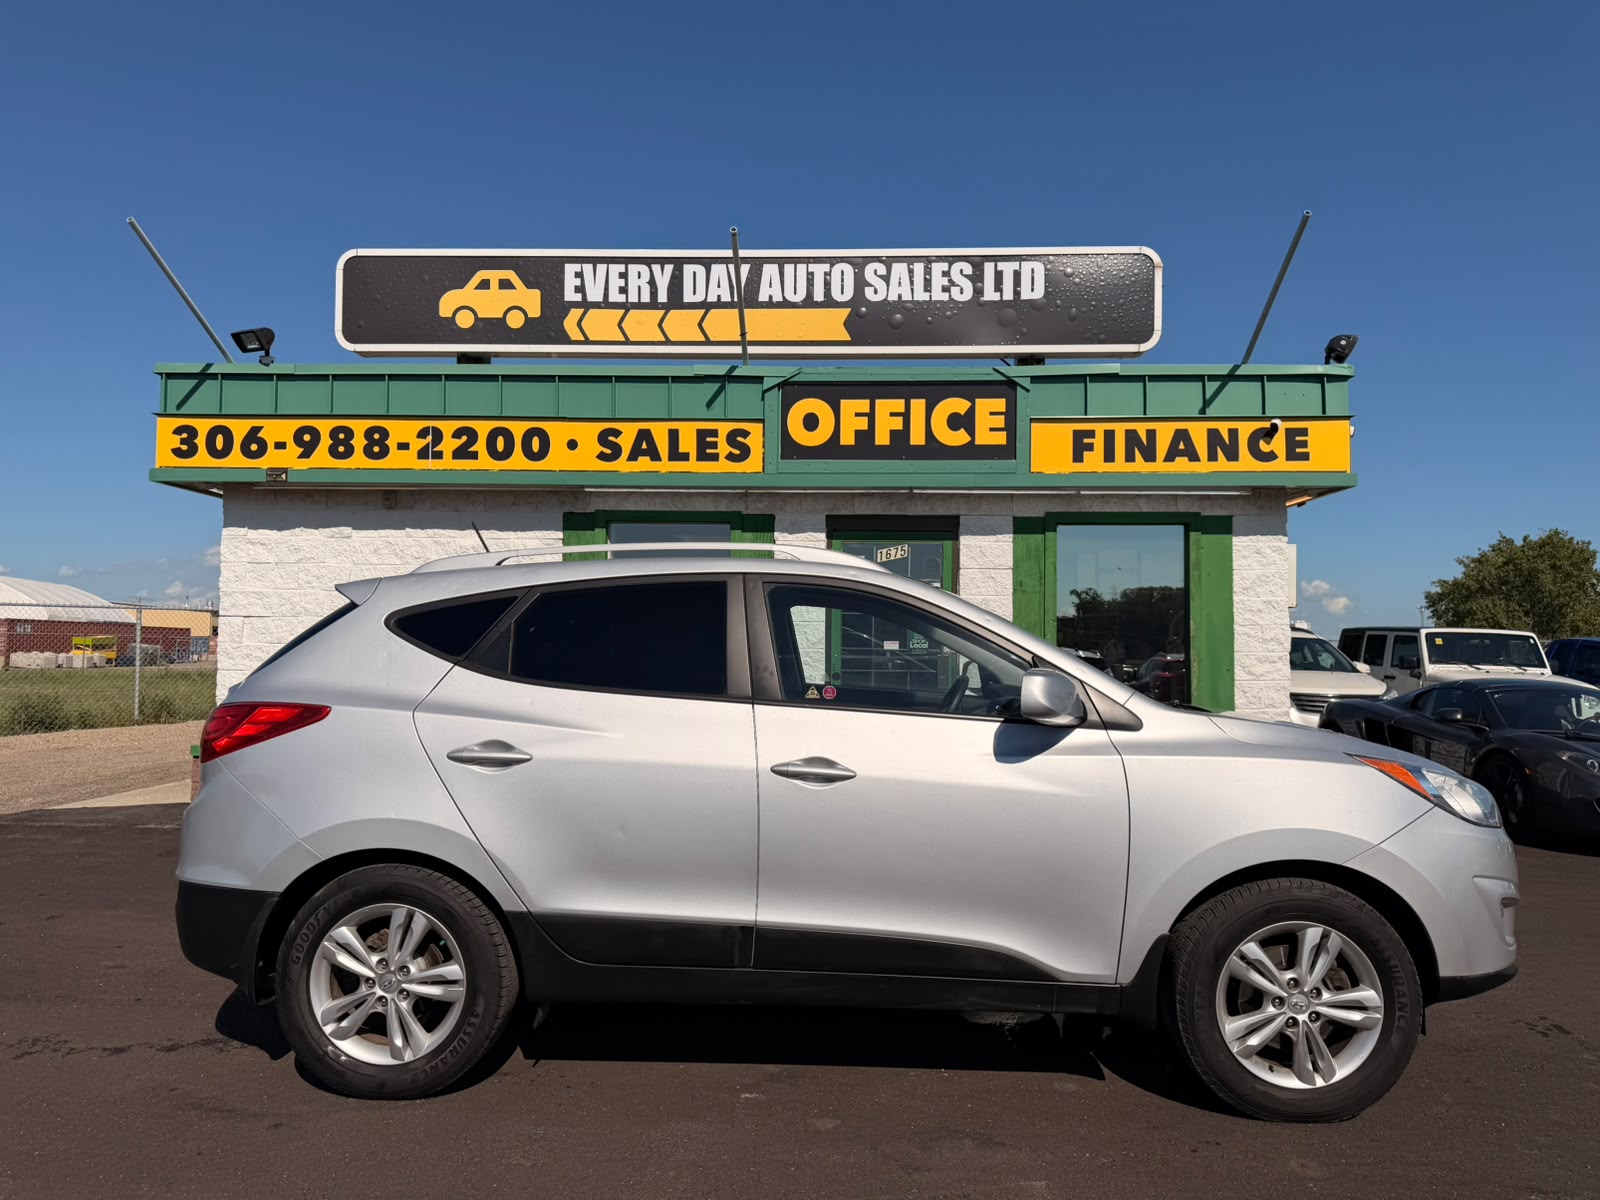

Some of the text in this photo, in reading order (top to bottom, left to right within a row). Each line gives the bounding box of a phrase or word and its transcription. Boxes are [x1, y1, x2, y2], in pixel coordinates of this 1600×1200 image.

[564, 261, 1046, 303] EVERY DAY AUTO SALES LTD
[787, 397, 1007, 447] OFFICE
[170, 423, 752, 463] 306-988-2200 SALES
[1072, 426, 1310, 463] FINANCE
[879, 545, 907, 562] 1675
